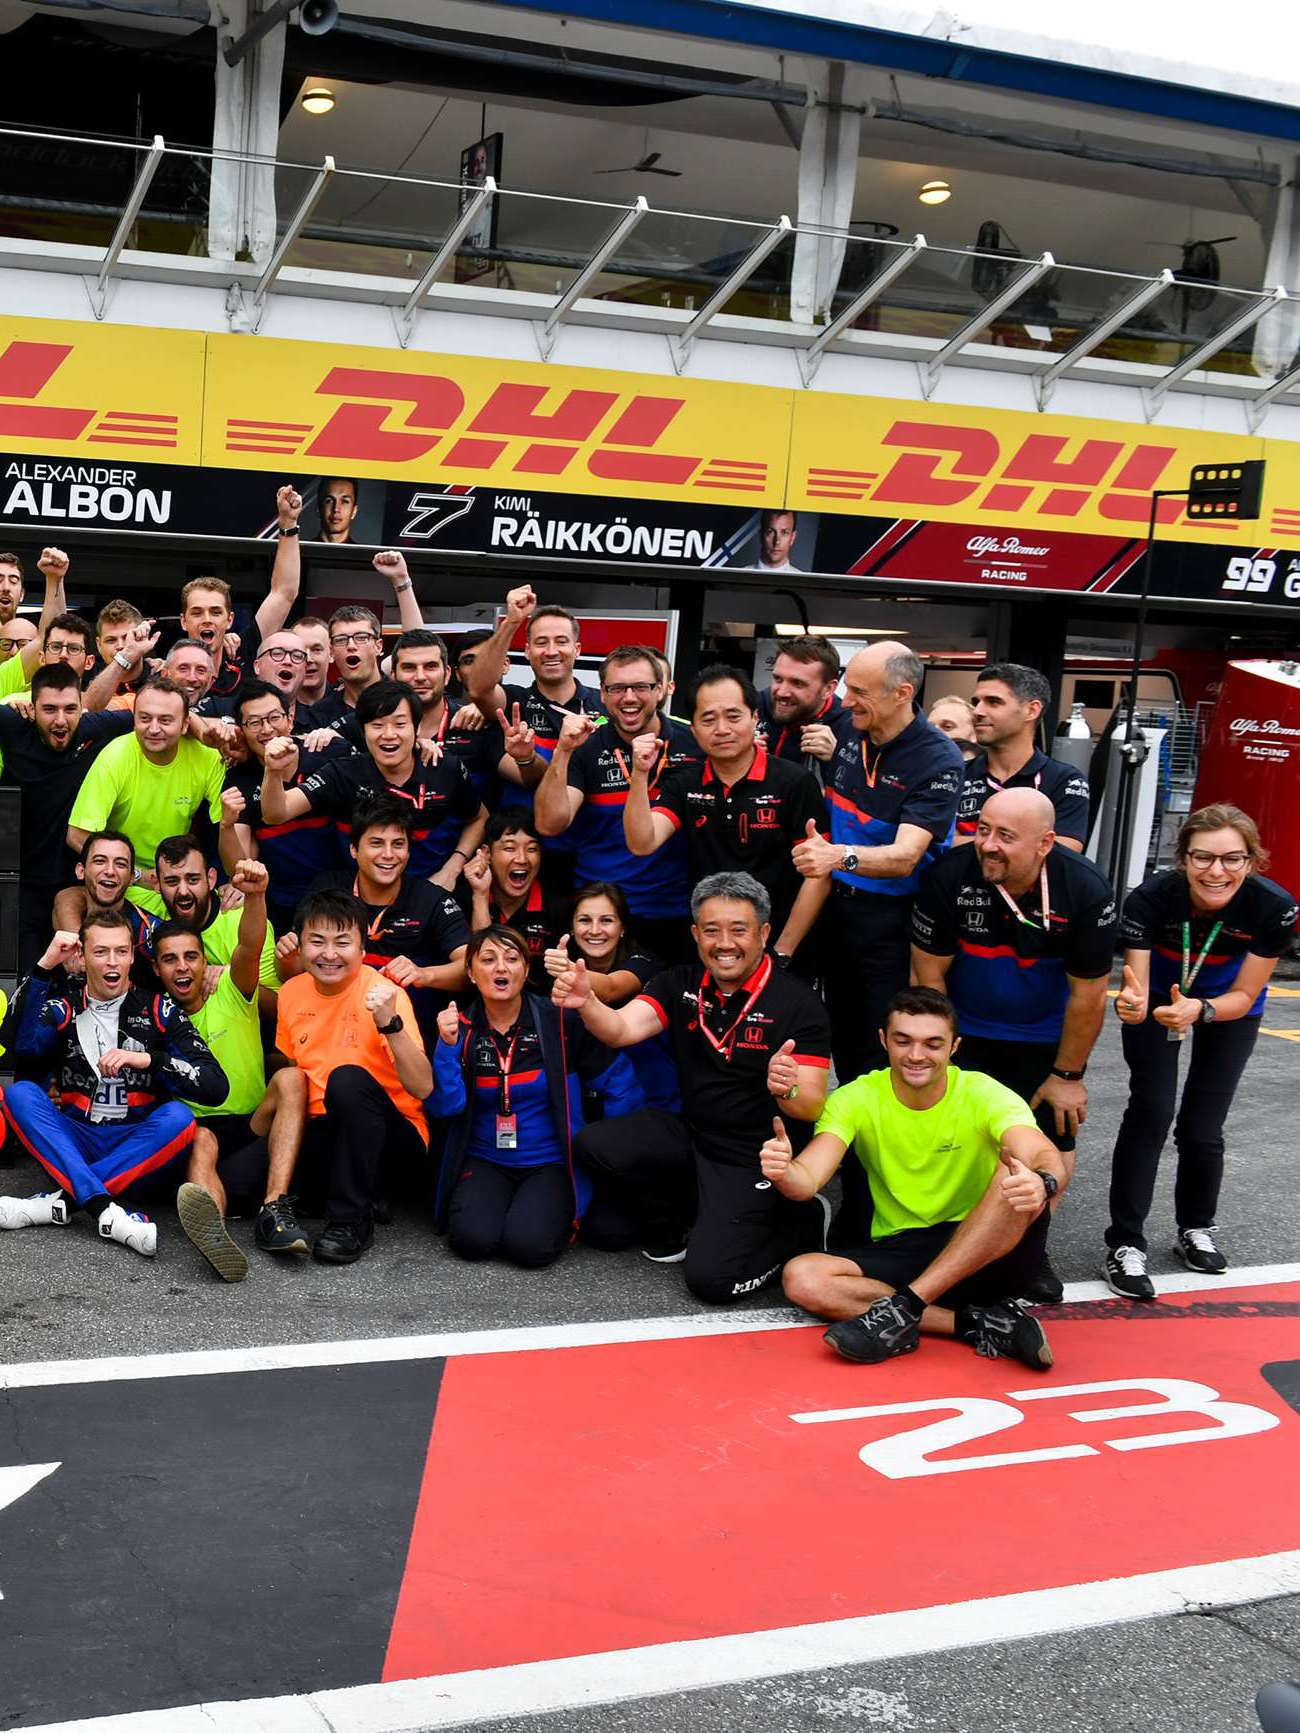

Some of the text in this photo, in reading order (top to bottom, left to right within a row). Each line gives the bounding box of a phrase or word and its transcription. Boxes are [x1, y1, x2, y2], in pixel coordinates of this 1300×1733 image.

[303, 367, 703, 484] DHL
[5, 462, 136, 486] ALEXANDER
[869, 421, 1188, 525] DHL
[2, 481, 172, 524] ALBON
[400, 492, 475, 539] 7
[494, 495, 531, 512] KIMI
[491, 511, 714, 559] RÄIKKÖNEN
[966, 536, 1050, 557] Alfa Romeo
[981, 569, 1027, 581] RACING
[1222, 557, 1277, 592] 99
[1230, 718, 1300, 736] Alfa Rome
[598, 756, 614, 766] Red
[1243, 745, 1290, 757] RACING
[788, 1378, 1280, 1479] 23
